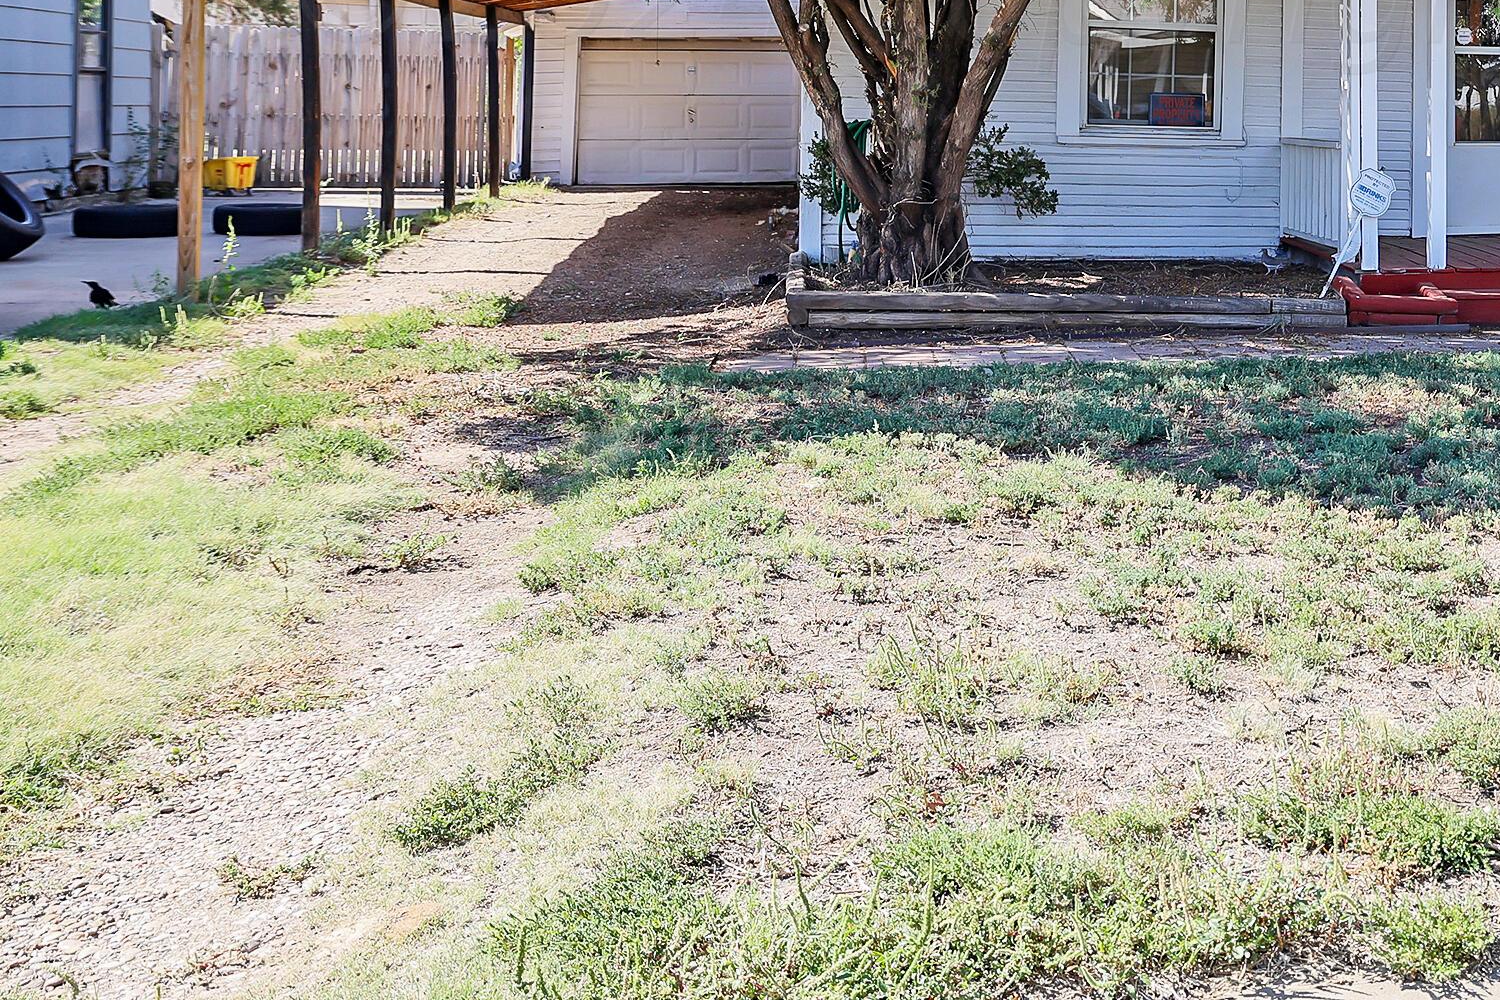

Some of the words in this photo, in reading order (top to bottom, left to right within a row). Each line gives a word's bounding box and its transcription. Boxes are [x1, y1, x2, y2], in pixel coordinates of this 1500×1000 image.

[1159, 96, 1195, 109] PRIVATE
[1153, 109, 1201, 121] PROPERTY
[1364, 174, 1391, 189] PROTECTED
[1360, 185, 1387, 203] BRINKS
